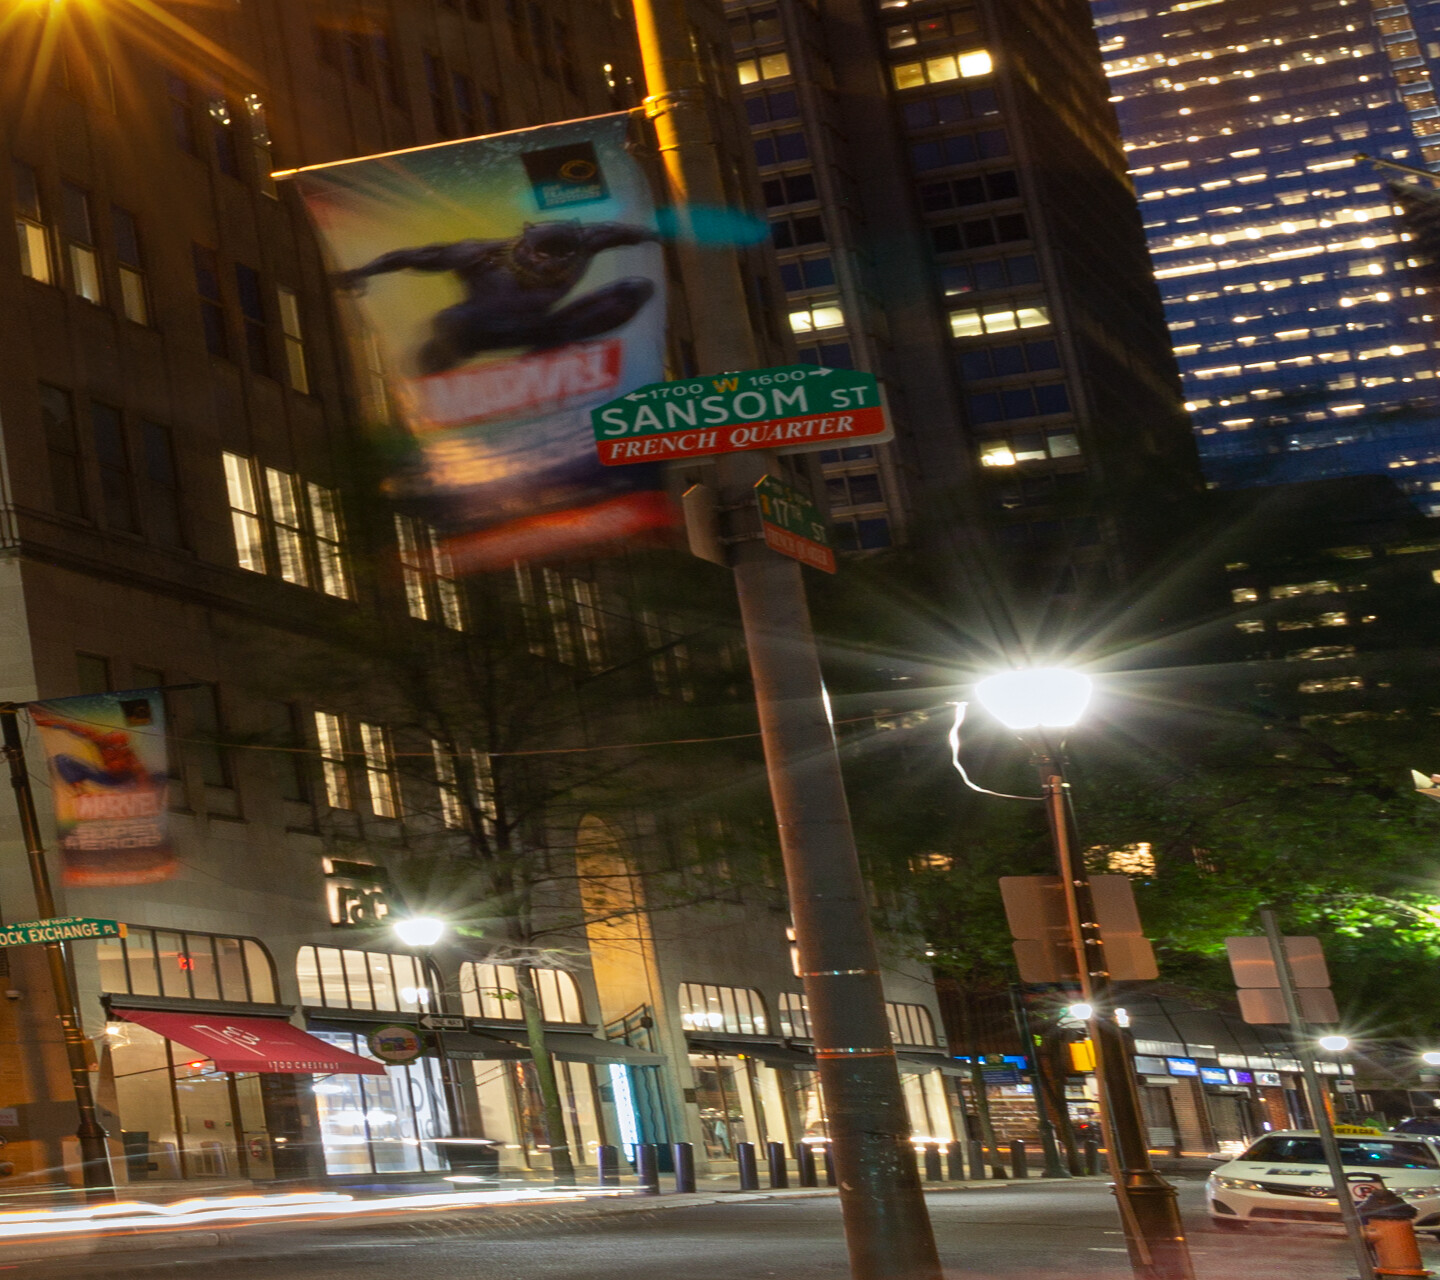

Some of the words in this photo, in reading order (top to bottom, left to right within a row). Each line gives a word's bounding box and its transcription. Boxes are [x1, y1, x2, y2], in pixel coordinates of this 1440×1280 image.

[649, 383, 704, 400] 1700
[712, 377, 739, 393] W
[749, 370, 806, 386] 1600
[601, 385, 808, 435] SANSOM
[830, 385, 869, 408] ST
[609, 431, 717, 460] FRENCH
[730, 415, 855, 448] QUARTER
[28, 922, 101, 942] EXCHANGE
[104, 925, 117, 934] PL
[39, 919, 51, 927] W
[268, 1061, 293, 1072] 1700
[294, 1061, 340, 1071] CHESTNUT
